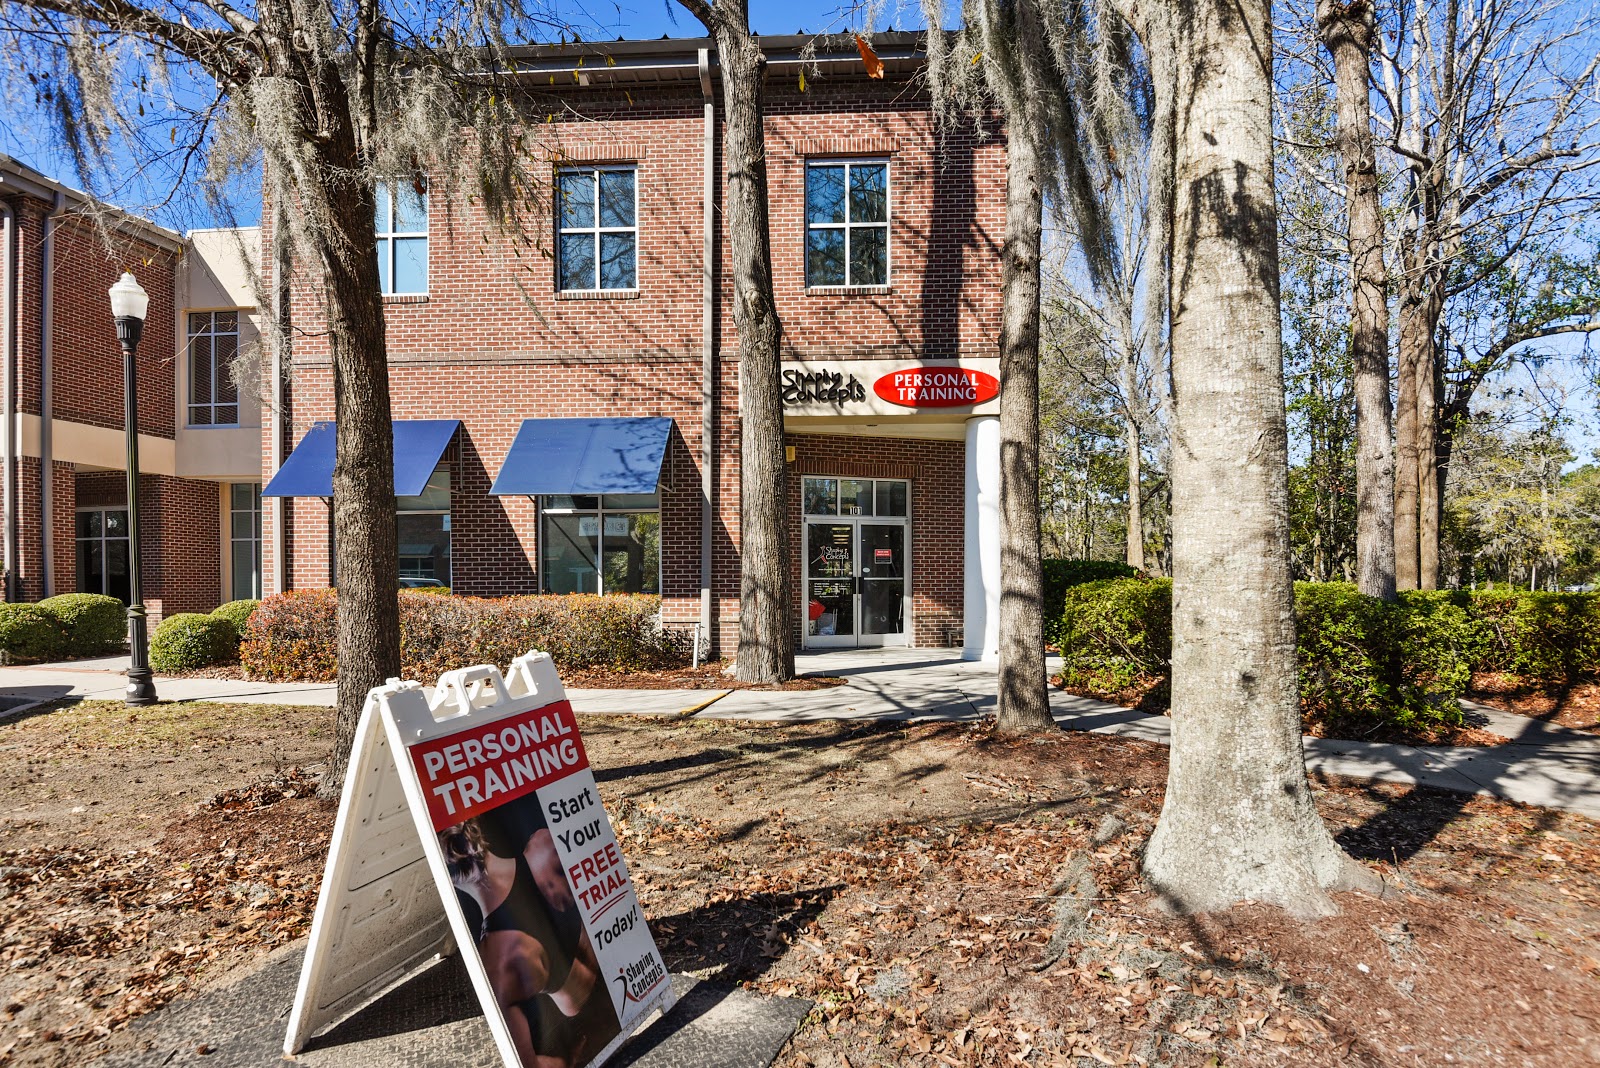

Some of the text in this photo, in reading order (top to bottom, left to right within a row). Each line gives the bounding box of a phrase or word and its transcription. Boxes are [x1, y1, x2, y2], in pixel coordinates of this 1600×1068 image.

[782, 369, 841, 389] Shaping
[782, 374, 866, 407] Concepts
[895, 374, 979, 387] PERSONAL
[897, 388, 977, 401] TRAINING
[850, 506, 863, 515] 101
[422, 712, 572, 781] PERSONAL
[433, 739, 580, 815] TRAINING
[548, 787, 594, 824] Start
[557, 818, 603, 854] Your
[568, 842, 620, 890] FREE
[578, 868, 627, 911] TRIAL
[593, 904, 638, 951] Today!
[626, 952, 655, 982] Shaping
[632, 963, 663, 998] Concepts
